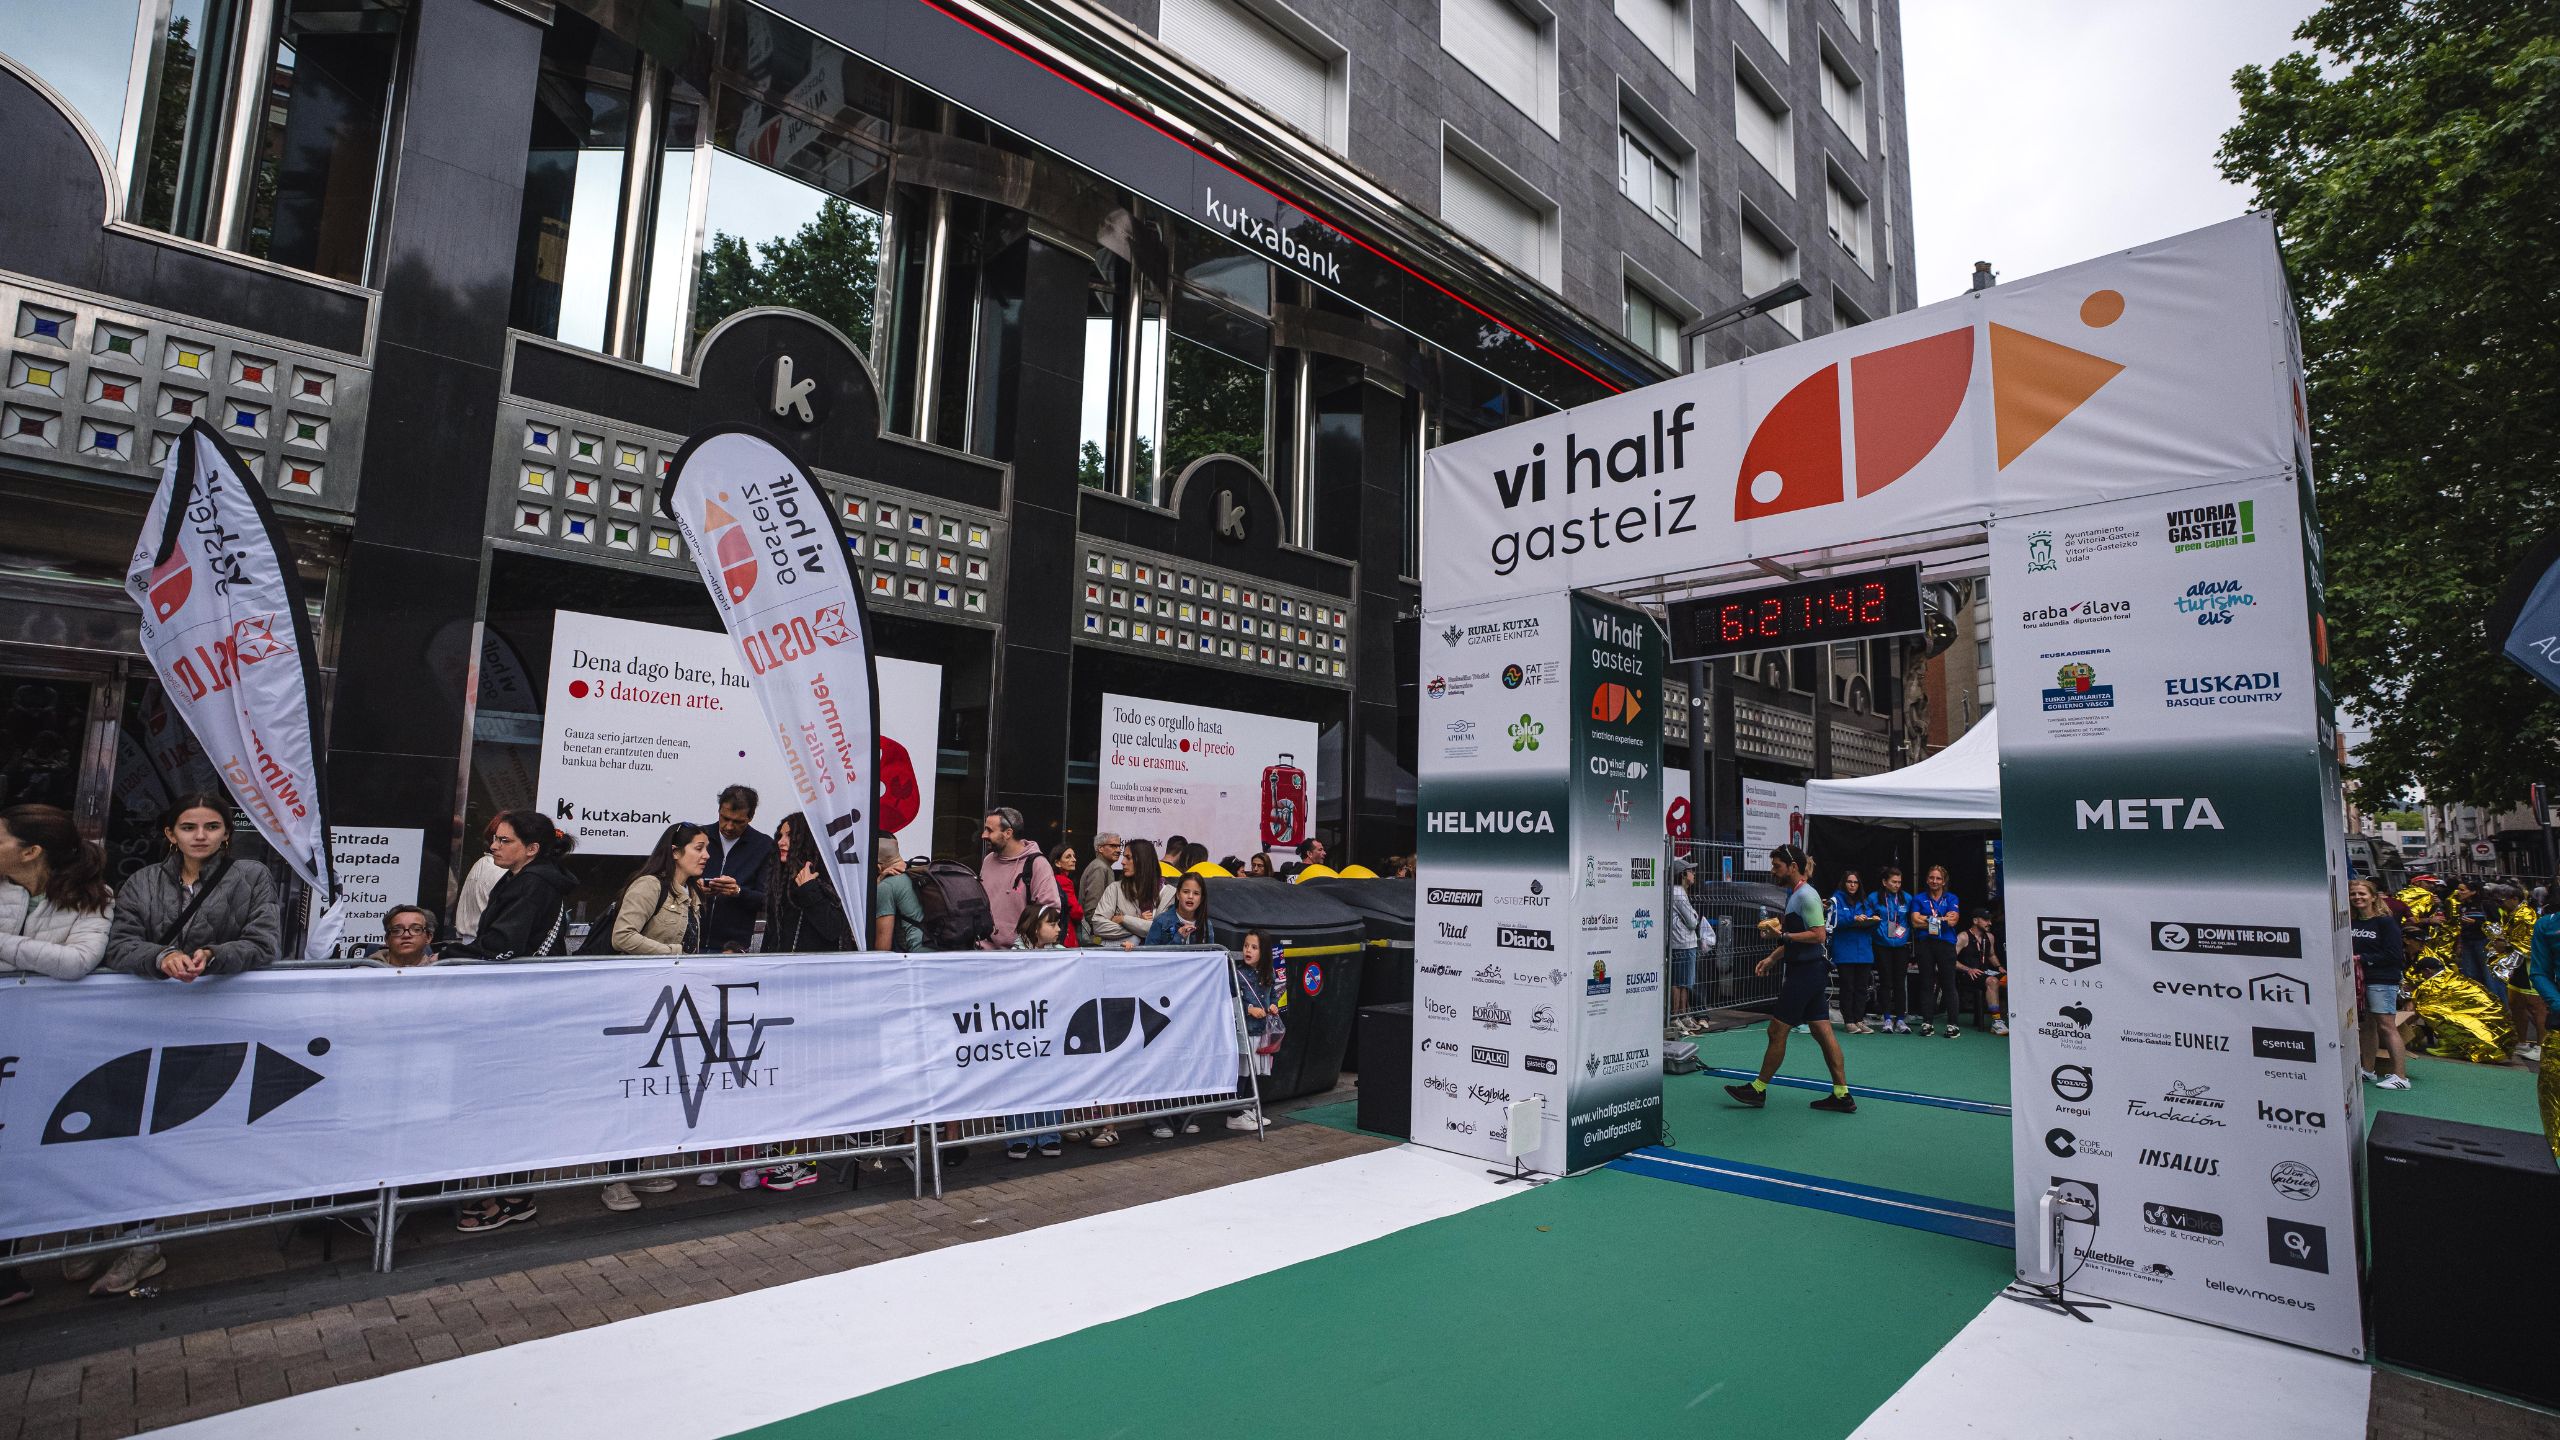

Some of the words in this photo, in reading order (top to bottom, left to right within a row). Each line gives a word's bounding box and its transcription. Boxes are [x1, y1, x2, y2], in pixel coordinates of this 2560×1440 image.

[1206, 186, 1341, 285] kutxabank
[1493, 442, 1547, 510] vi
[1566, 402, 1695, 495] half
[2166, 503, 2236, 527] VITORIA
[1491, 488, 1697, 576] gasteiz
[2064, 526, 2124, 541] Ayuntamiento
[2077, 530, 2140, 545] Vitoria-Gasteiz
[2168, 519, 2238, 544] GASTEIZ
[2065, 541, 2138, 556] Vitoria-Gasteizko
[2174, 541, 2202, 554] green
[2204, 535, 2238, 549] capital
[2066, 555, 2090, 563] Udala
[1721, 583, 1885, 641] 6:21:42
[2022, 606, 2068, 622] araba
[2082, 600, 2131, 616] álava
[1468, 623, 1500, 636] RURAL
[1502, 618, 1539, 632] KUTXA
[2023, 622, 2037, 630] foru
[2039, 620, 2070, 628] aldundia
[2073, 615, 2112, 625] diputación
[1468, 633, 1501, 646] GIZARTE
[1503, 629, 1540, 641] EKINTZA
[1592, 614, 1608, 641] vi
[1612, 616, 1643, 651] half
[571, 649, 622, 675] Dena
[626, 655, 669, 683] dago
[674, 661, 716, 687] bare,
[1526, 663, 1543, 674] FAT
[1592, 648, 1643, 676] gasteiz
[1524, 675, 1543, 686] ATF
[2165, 671, 2280, 696] EUSKADI
[593, 679, 606, 698] 3
[610, 681, 682, 708] datozen
[686, 691, 725, 711] arte.
[2166, 696, 2215, 708] BASQUE
[2219, 692, 2283, 705] COUNTRY
[2047, 702, 2084, 710] GOBIERNO
[1113, 706, 1142, 725] Todo
[1144, 714, 1156, 726] es
[1158, 715, 1195, 733] orgullo
[1197, 717, 1223, 735] hasta
[564, 727, 595, 740] Gauza
[597, 732, 620, 742] serio
[620, 732, 654, 745] jartzen
[656, 736, 691, 749] denean,
[1112, 732, 1133, 748] que
[1136, 732, 1178, 750] calculas
[1192, 737, 1202, 752] el
[1204, 741, 1235, 757] precio
[1615, 735, 1644, 746] experience
[563, 741, 602, 754] benetan
[604, 747, 654, 758] erantzuten
[656, 749, 679, 760] duen
[562, 755, 597, 768] bankua
[599, 758, 627, 769] behar
[628, 760, 654, 772] duzu.
[1111, 749, 1125, 766] de
[1128, 755, 1140, 767] su
[1143, 757, 1189, 772] erasmus.
[1590, 756, 1609, 775] CD
[1110, 781, 1133, 791] Cuando
[1109, 793, 1136, 802] necesitas
[581, 807, 672, 824] kutxabank
[1427, 811, 1555, 834] HELMUGA
[2075, 797, 2225, 830] META
[330, 833, 389, 845] Entrada
[580, 827, 629, 838] Benetan.
[333, 852, 400, 866] daptada
[320, 891, 387, 903] eokitua
[1442, 890, 1482, 905] ENERVIT
[1438, 921, 1469, 939] Vital
[2197, 928, 2235, 940] DOWN
[2236, 929, 2255, 942] THE
[2257, 931, 2290, 944] ROAD
[1501, 930, 1548, 949] Diario
[1626, 971, 1658, 986] EUSKADI
[2039, 977, 2104, 989] RACING
[2152, 980, 2243, 999] evento
[2260, 983, 2296, 1003] kit
[952, 1003, 983, 1035] vi
[991, 998, 1050, 1033] half
[1472, 1005, 1512, 1022] FORONDA
[2038, 1027, 2092, 1040] sagardoa
[2046, 1021, 2074, 1029] euskal
[1435, 1041, 1459, 1051] CANO
[2174, 1031, 2230, 1052] EUNEIZ
[956, 1036, 1052, 1069] gasteiz
[1602, 1052, 1625, 1065] RURAL
[1625, 1048, 1650, 1061] KUTXA
[619, 1066, 780, 1099] TRIEVENT
[2057, 1079, 2088, 1088] VOLVO
[1570, 1094, 1660, 1127] www.vihalfgasteiz.com
[2055, 1104, 2091, 1117] Arregui
[2163, 1095, 2225, 1109] MICHELIN
[2127, 1099, 2227, 1127] Fundación
[2257, 1100, 2326, 1129] kora
[1583, 1118, 1642, 1147] @vihalfgasteiz
[2266, 1123, 2295, 1132] GREEN
[2298, 1127, 2319, 1135] CITY
[2079, 1139, 2101, 1149] COPE
[2079, 1147, 2113, 1158] EUSKADI
[2143, 1224, 2167, 1236] bikes
[2171, 1230, 2177, 1238] &
[2181, 1232, 2225, 1248] triathlon
[2073, 1247, 2136, 1269] bulletbike
[2085, 1262, 2099, 1270] Bike
[2100, 1265, 2132, 1277] Transport
[2133, 1273, 2164, 1285] Company
